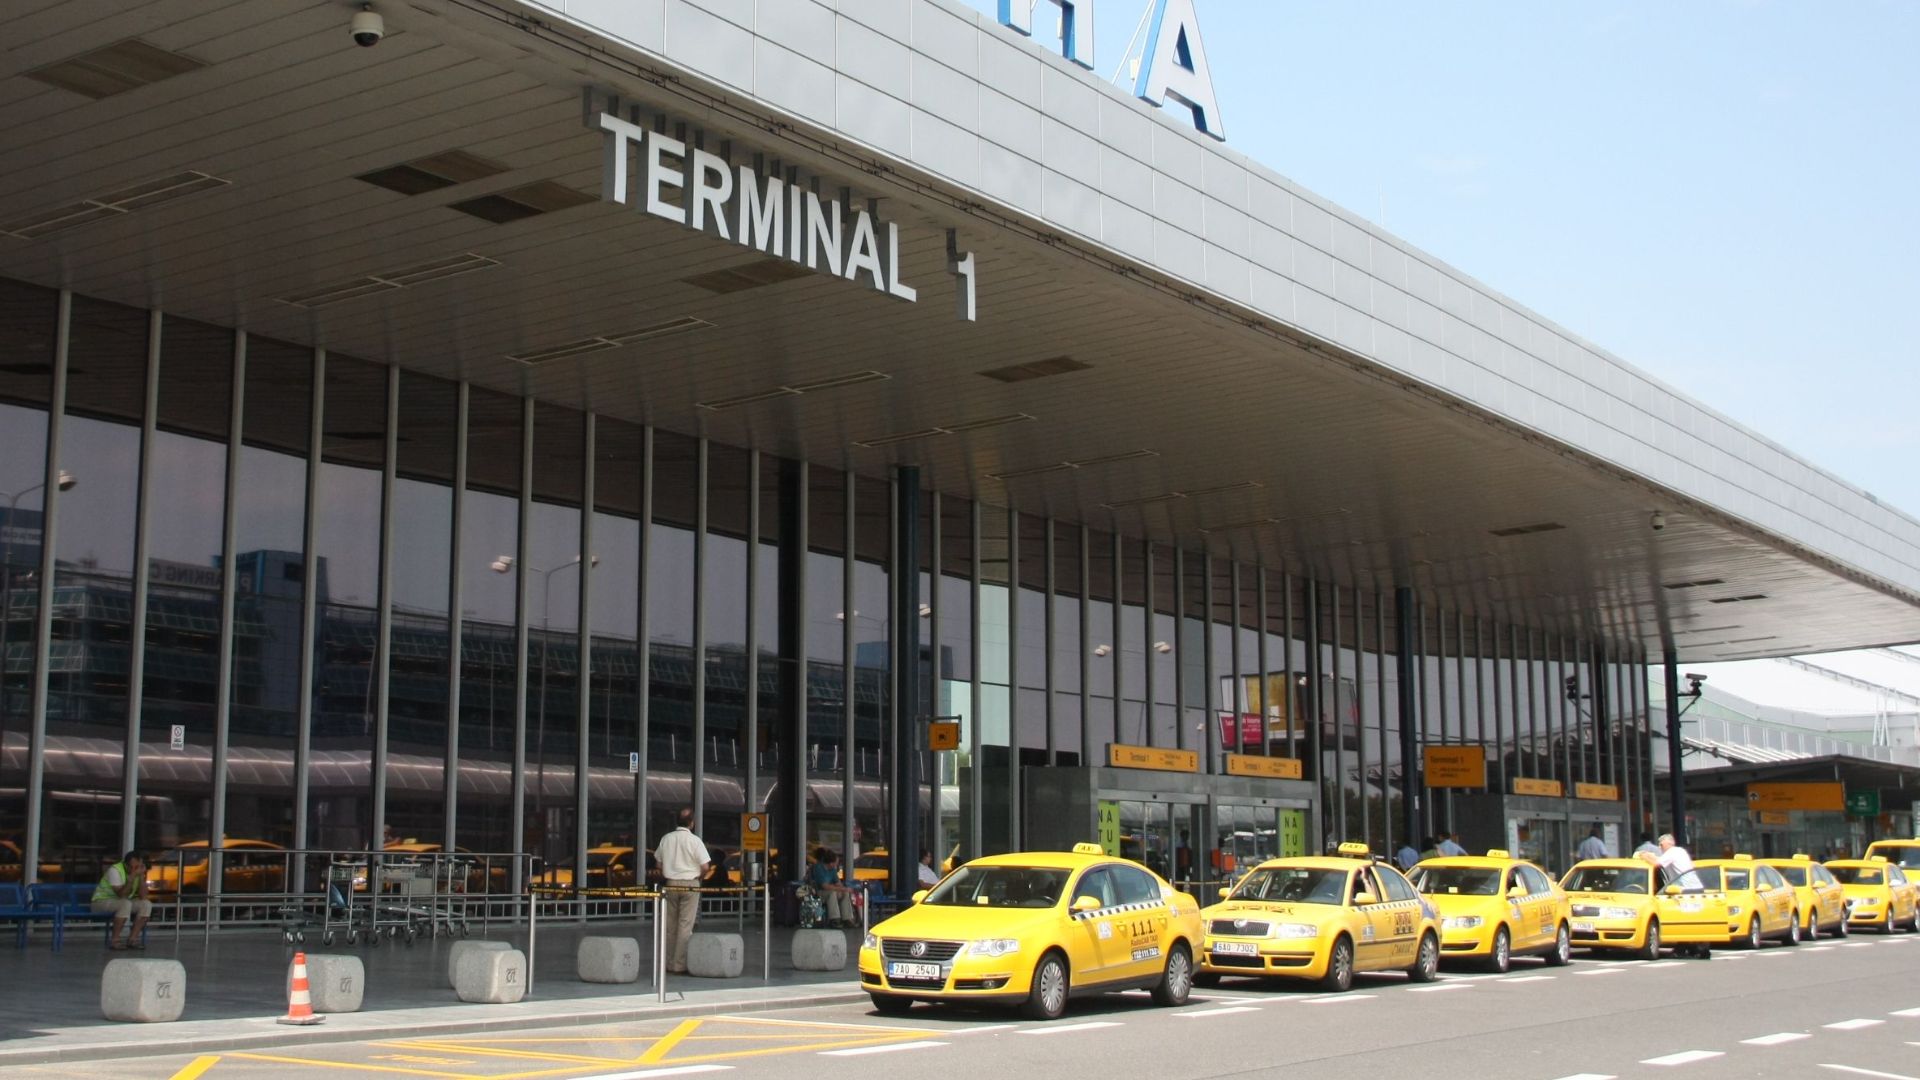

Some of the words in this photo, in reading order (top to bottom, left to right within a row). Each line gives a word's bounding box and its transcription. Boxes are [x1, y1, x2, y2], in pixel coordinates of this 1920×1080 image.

[600, 112, 917, 302] TERMINAL
[957, 251, 976, 322] 1
[1236, 943, 1254, 953] 7302
[915, 965, 936, 975] 2540
